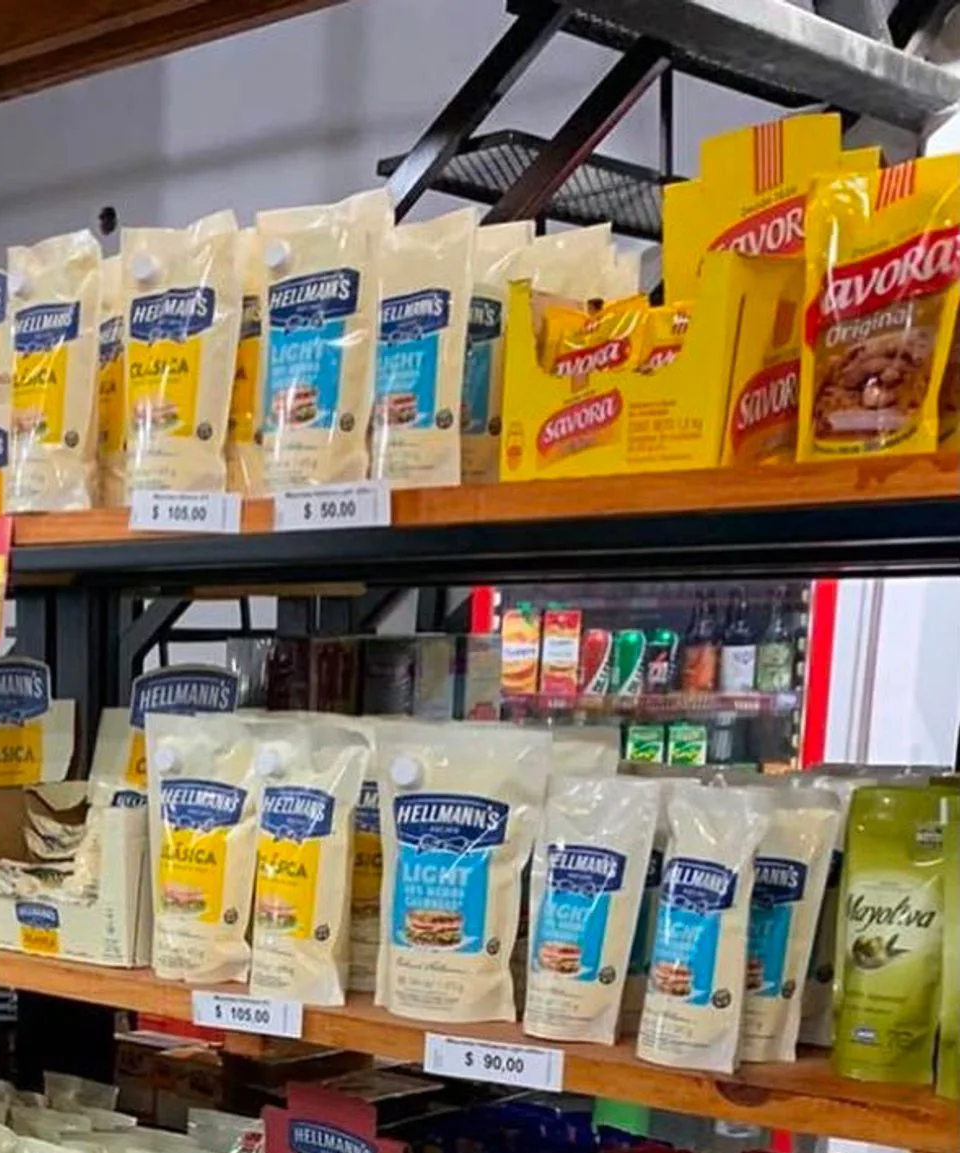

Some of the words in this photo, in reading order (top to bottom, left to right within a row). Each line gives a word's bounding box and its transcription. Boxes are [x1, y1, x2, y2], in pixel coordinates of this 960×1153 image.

[381, 294, 443, 323] ELLMANN'S
[140, 680, 231, 710] HELLMANN'S
[397, 802, 501, 831] HELLMANN'S
[402, 861, 473, 886] LIGHT
[464, 1051, 474, 1067] $
